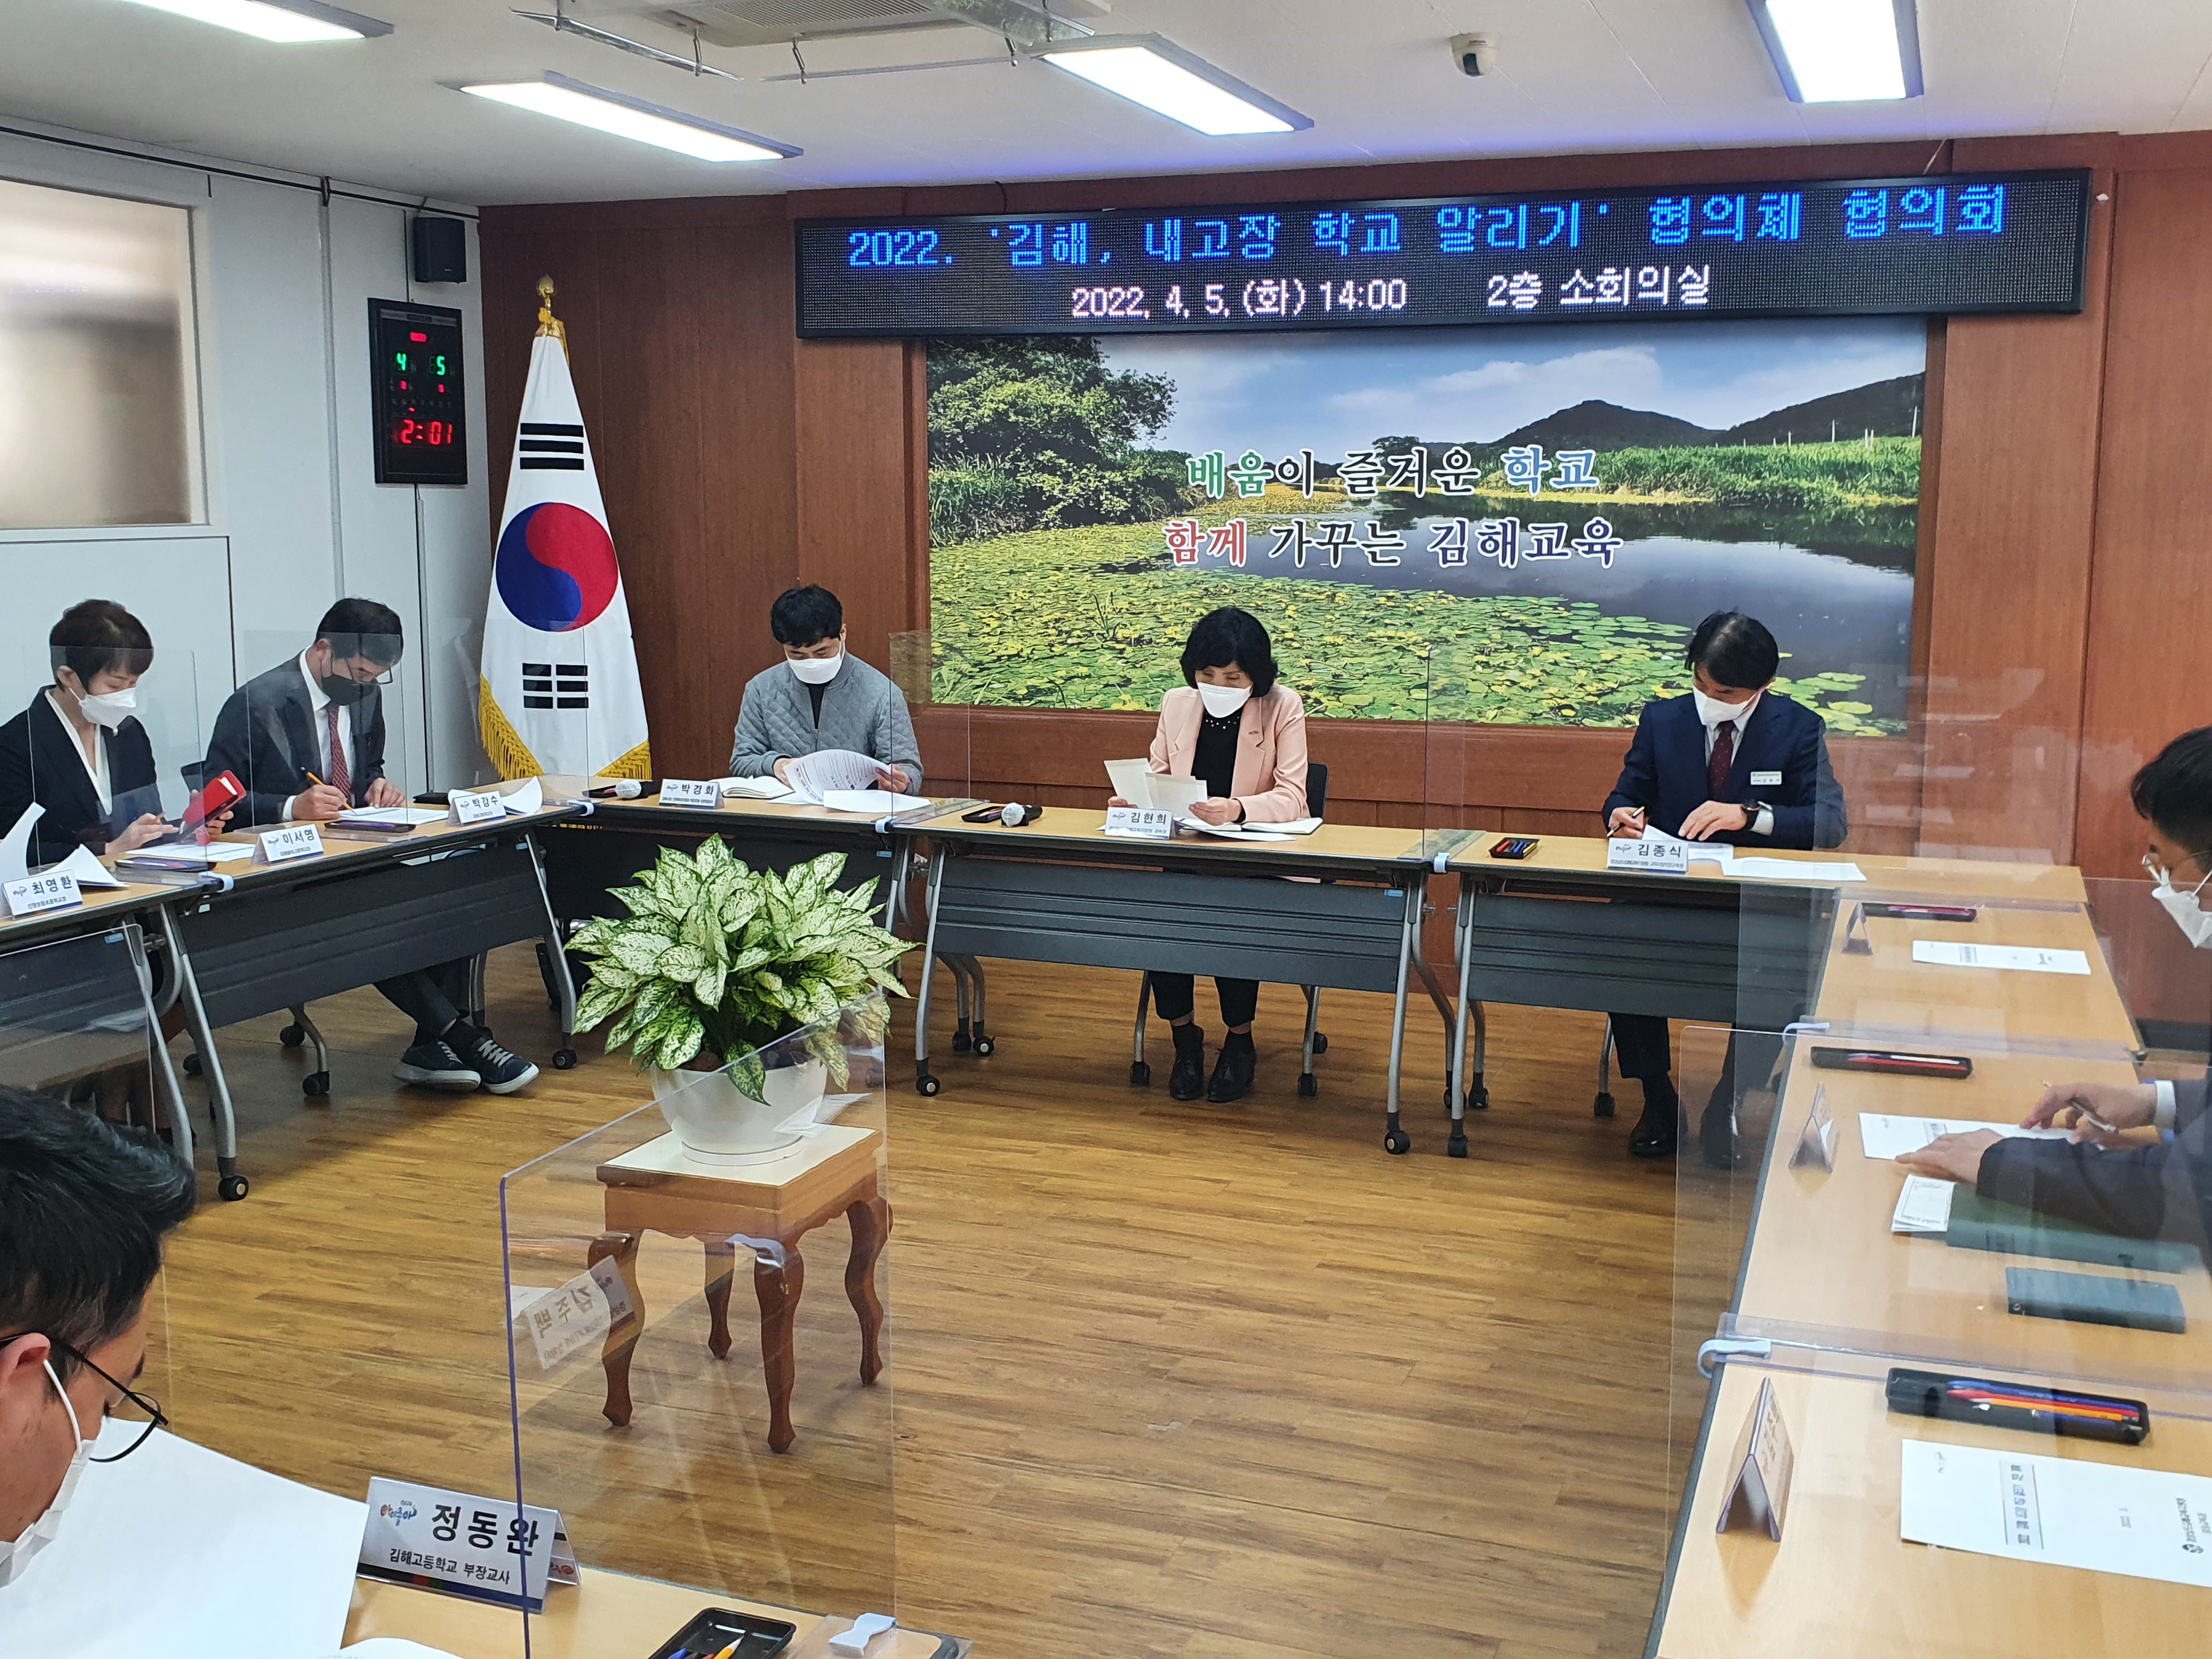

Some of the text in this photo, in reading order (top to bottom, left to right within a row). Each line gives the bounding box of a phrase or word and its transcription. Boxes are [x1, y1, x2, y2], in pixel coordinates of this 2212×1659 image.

[849, 230, 954, 267] 2022.
[1144, 213, 1282, 262] 내고장
[1312, 211, 1402, 257] 학교
[1648, 191, 1803, 246] 협의체
[1842, 184, 2006, 239] 협의회
[1319, 278, 1407, 312] 14:00
[1487, 270, 1543, 310] 2층
[1560, 264, 1709, 306] 소회의실
[400, 419, 453, 445] 2:01
[1187, 446, 1599, 498] 배움이 즐거운 학교
[1164, 518, 1622, 567] 함께 가꾸는 김해교육
[282, 828, 315, 845] 이서영
[1638, 843, 1681, 859] 김종식
[431, 1503, 539, 1556] 정동완
[390, 1548, 510, 1585] 김해고등학교 부장교사
